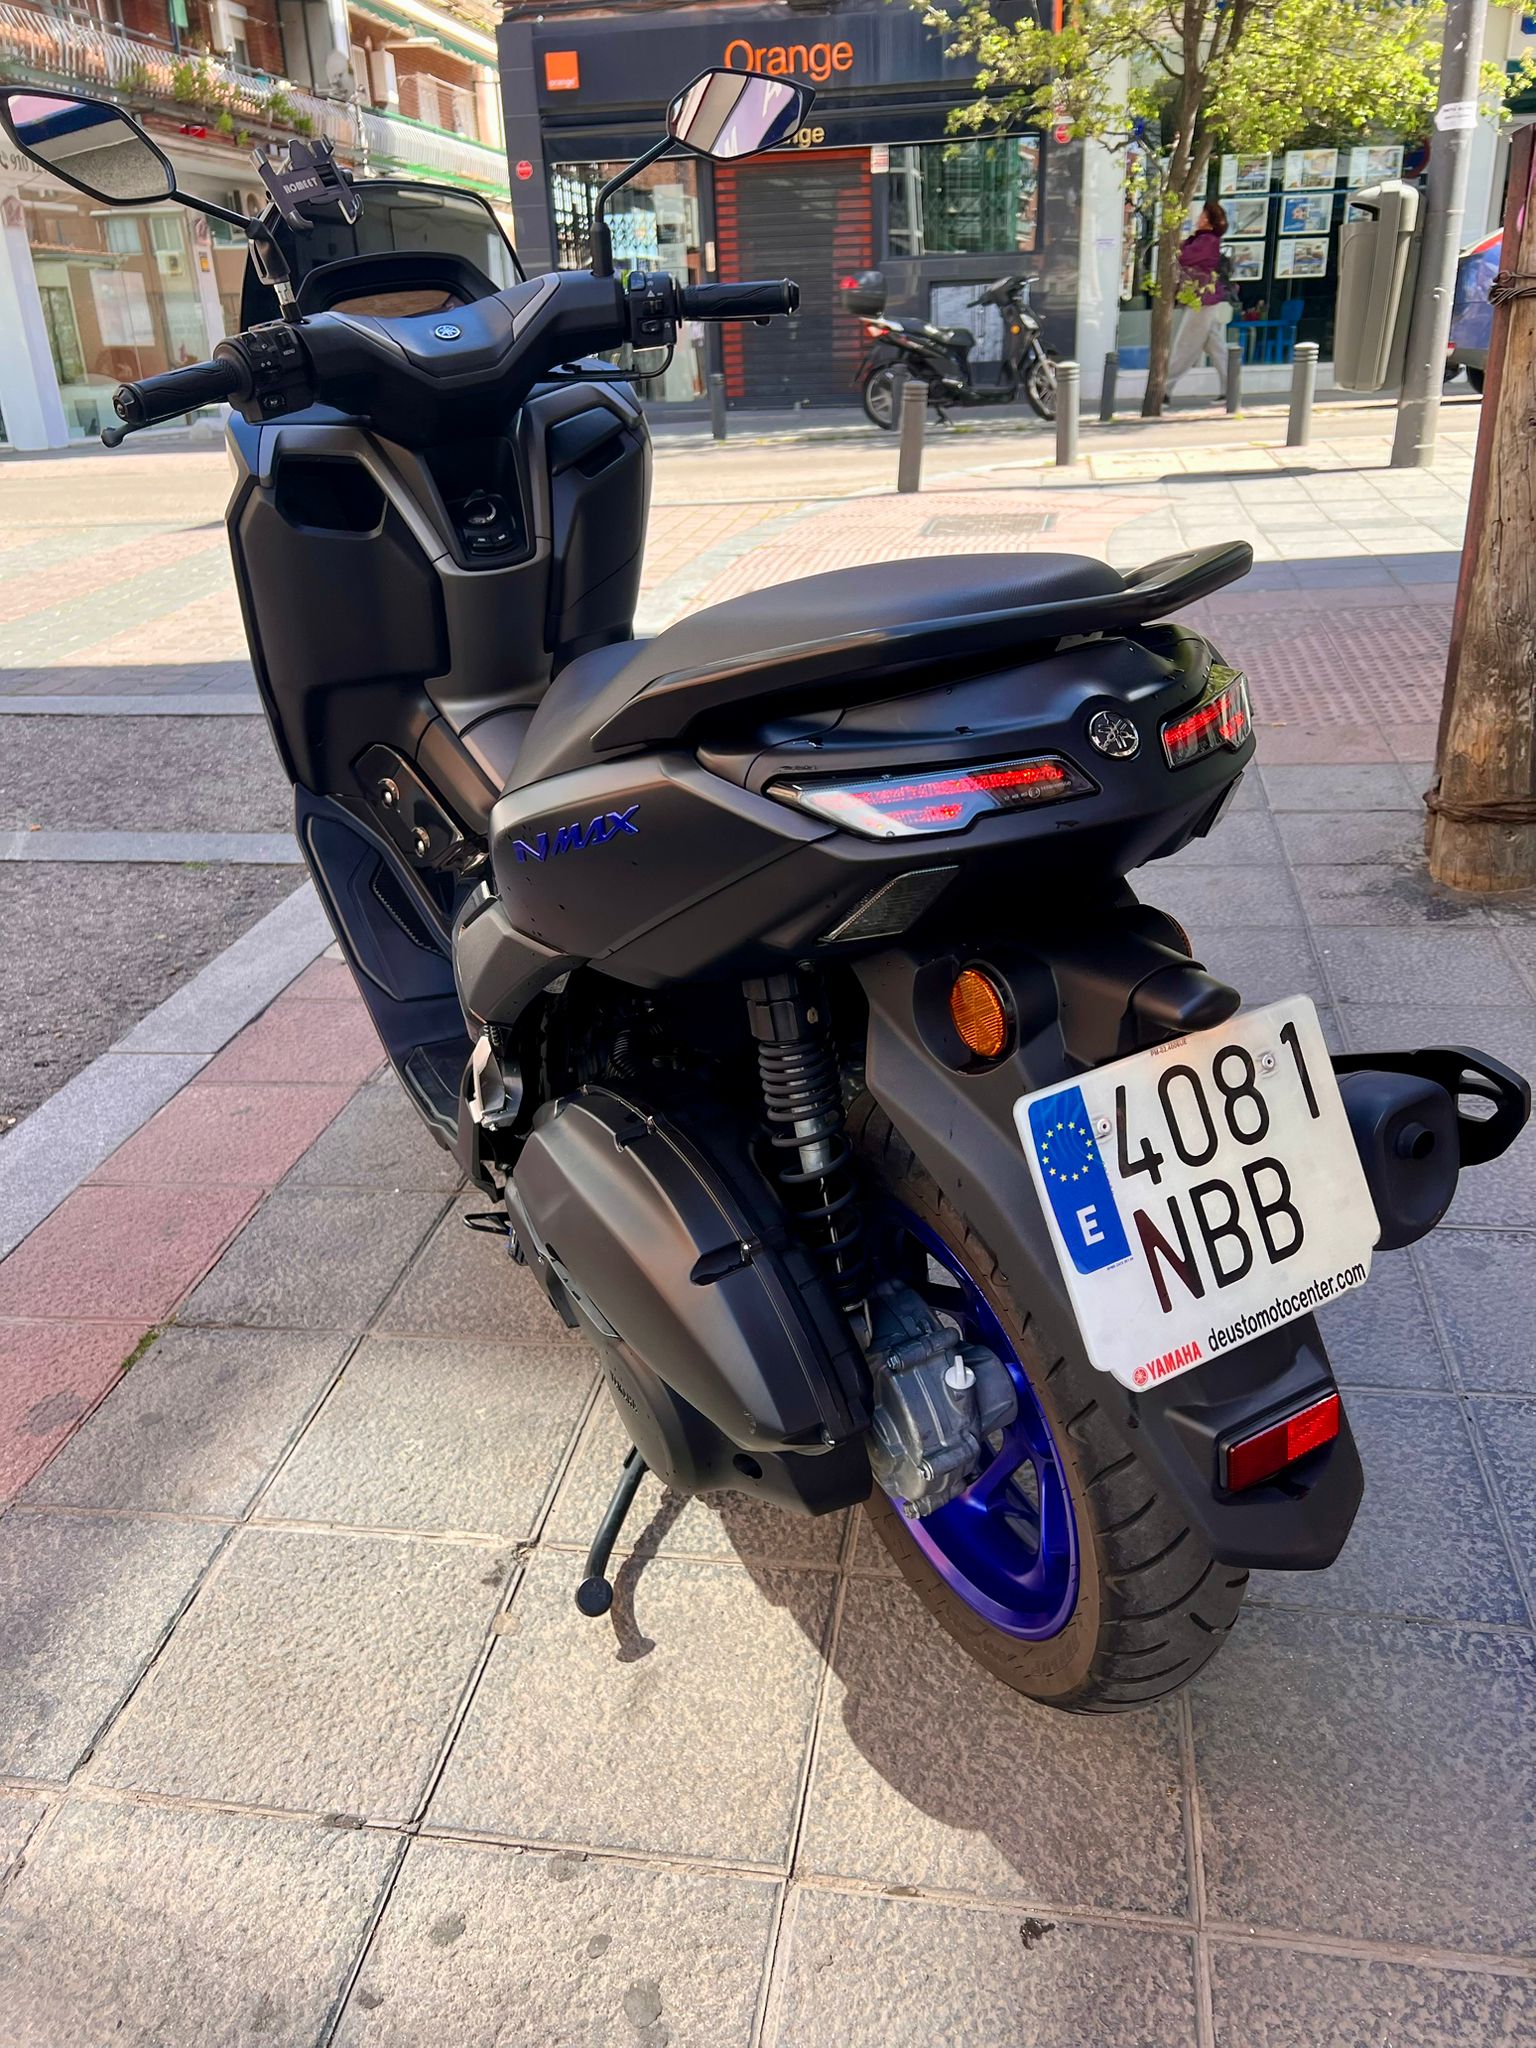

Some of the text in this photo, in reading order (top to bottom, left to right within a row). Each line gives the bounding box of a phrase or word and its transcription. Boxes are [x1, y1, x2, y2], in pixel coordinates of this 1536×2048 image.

[724, 38, 854, 82] Orange
[512, 804, 640, 863] NMAX
[1115, 1022, 1320, 1185] 4081
[1076, 1204, 1105, 1247] E
[1133, 1157, 1304, 1314] NBB
[1146, 1263, 1366, 1380] YAMAHA deustomotocenter.com
